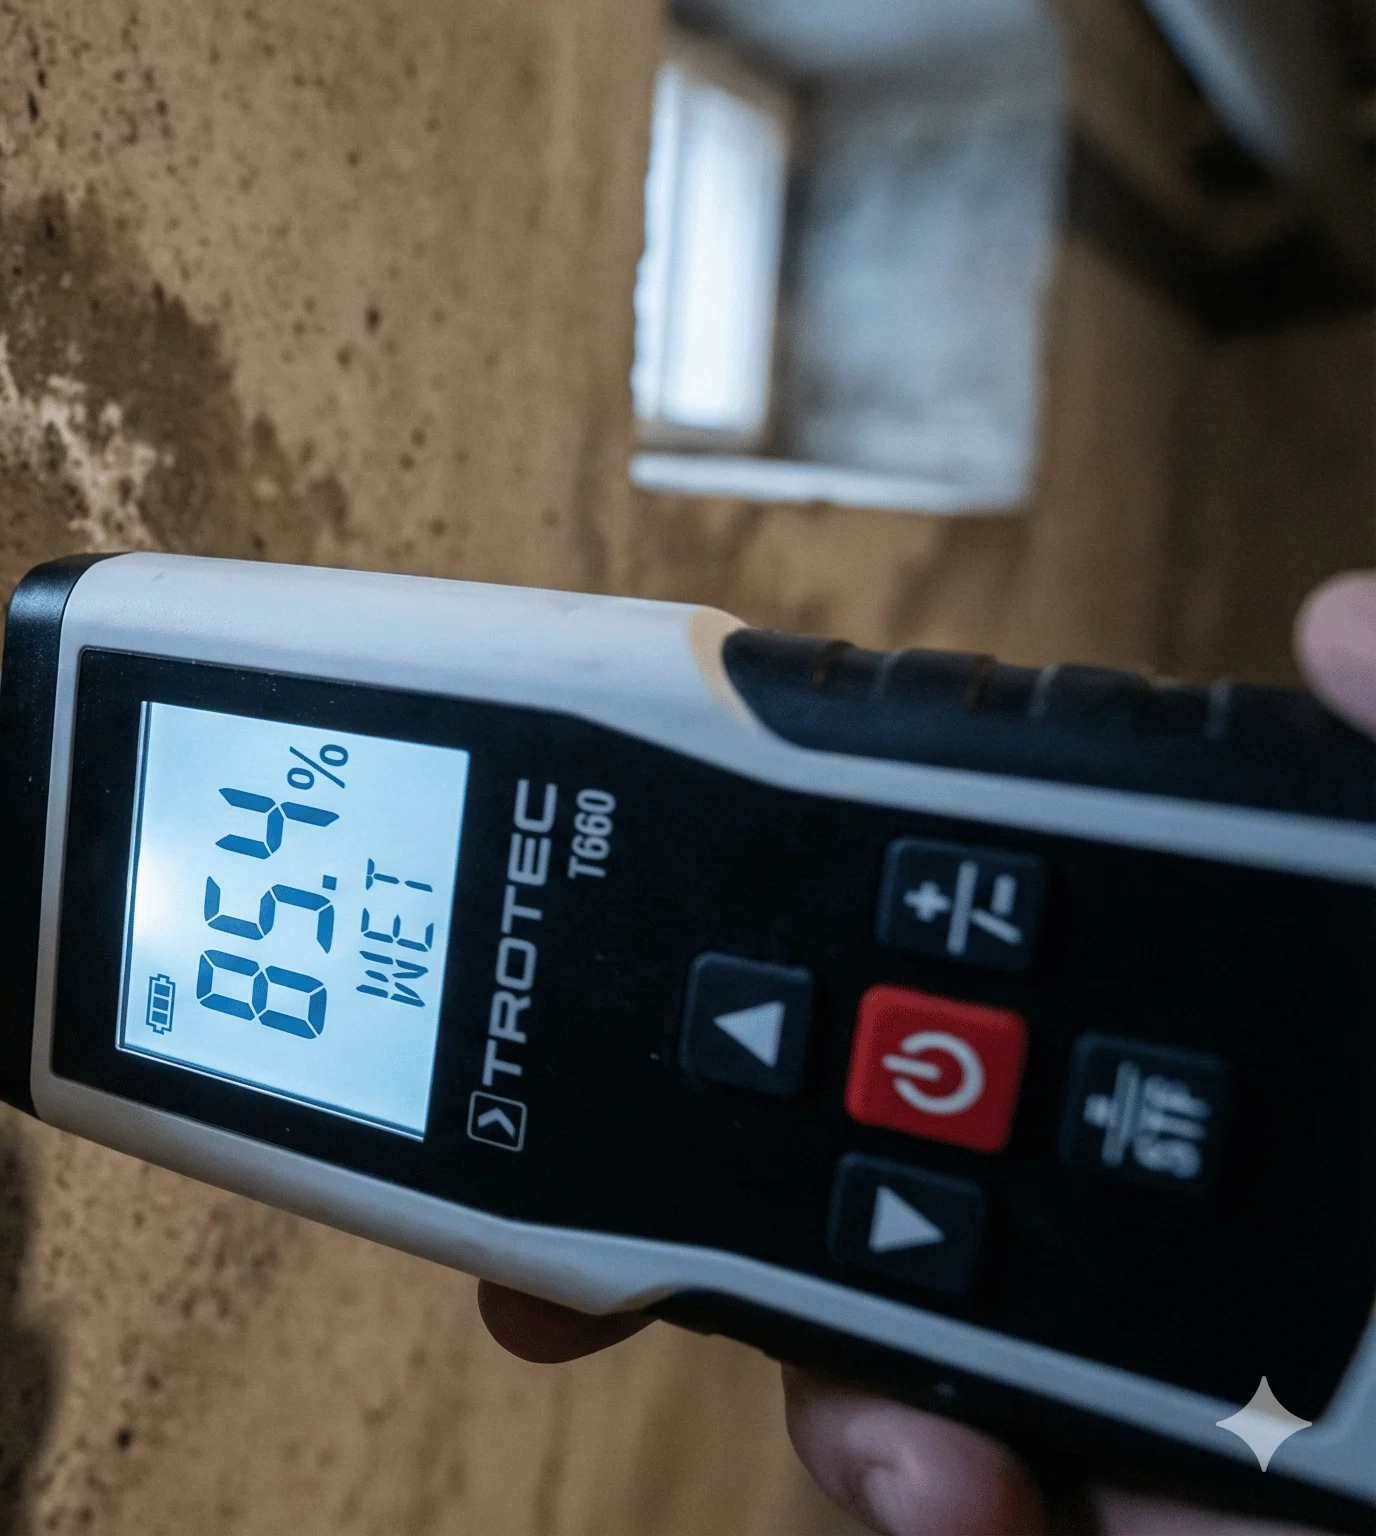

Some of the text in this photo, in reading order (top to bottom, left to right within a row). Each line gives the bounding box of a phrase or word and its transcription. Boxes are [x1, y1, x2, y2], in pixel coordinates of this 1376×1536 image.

[567, 787, 617, 881] T660
[355, 857, 435, 1009] WET
[482, 778, 558, 1087] TROTEC
